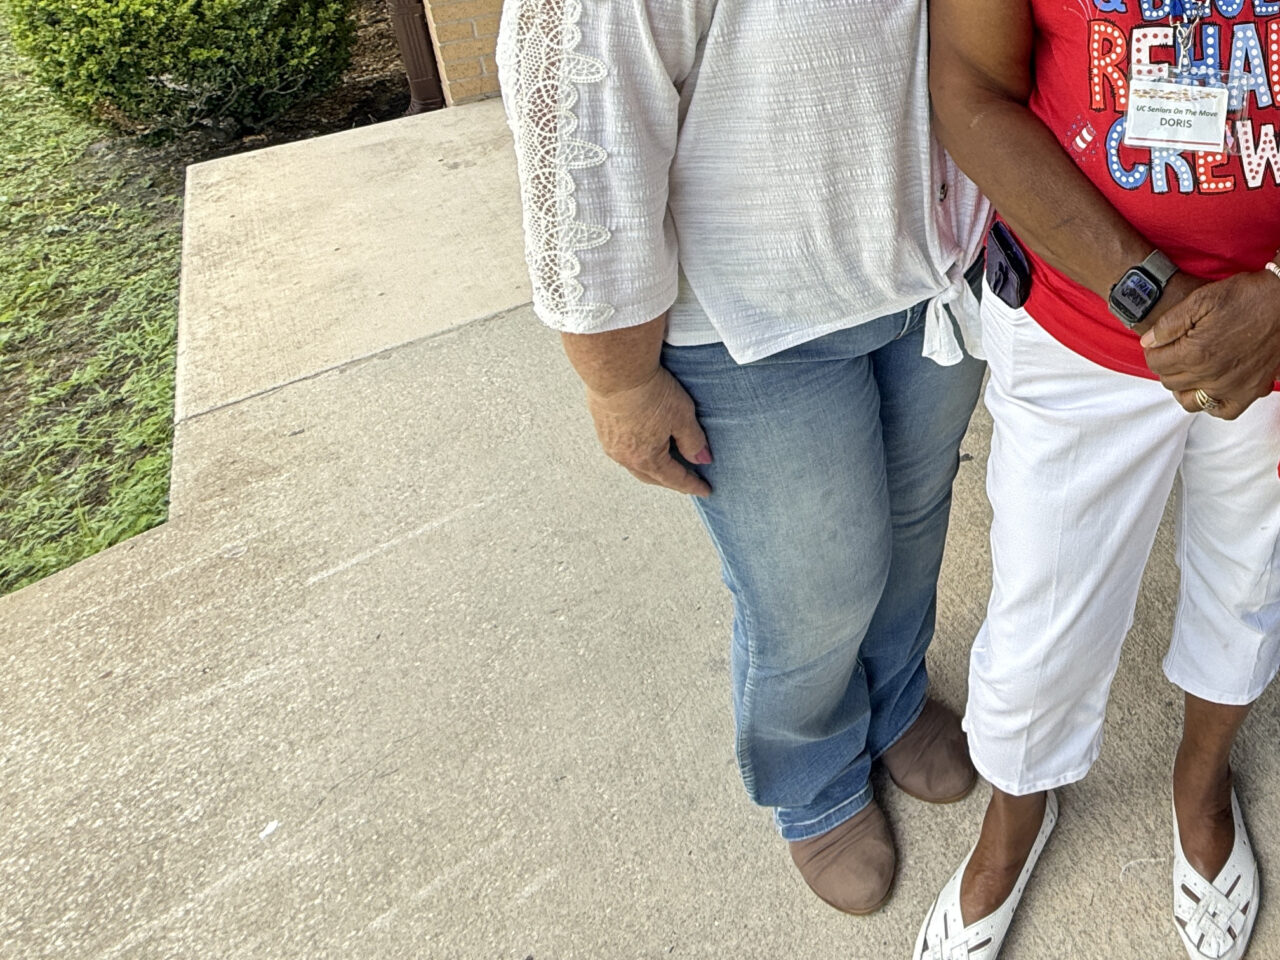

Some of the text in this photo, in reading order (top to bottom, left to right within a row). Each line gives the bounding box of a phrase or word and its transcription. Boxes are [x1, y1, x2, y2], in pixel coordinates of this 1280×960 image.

[1136, 105, 1146, 113] UC
[1147, 106, 1172, 114] Seniors
[1185, 108, 1197, 116] The
[1198, 110, 1219, 118] Move
[1159, 117, 1193, 129] DORIS
